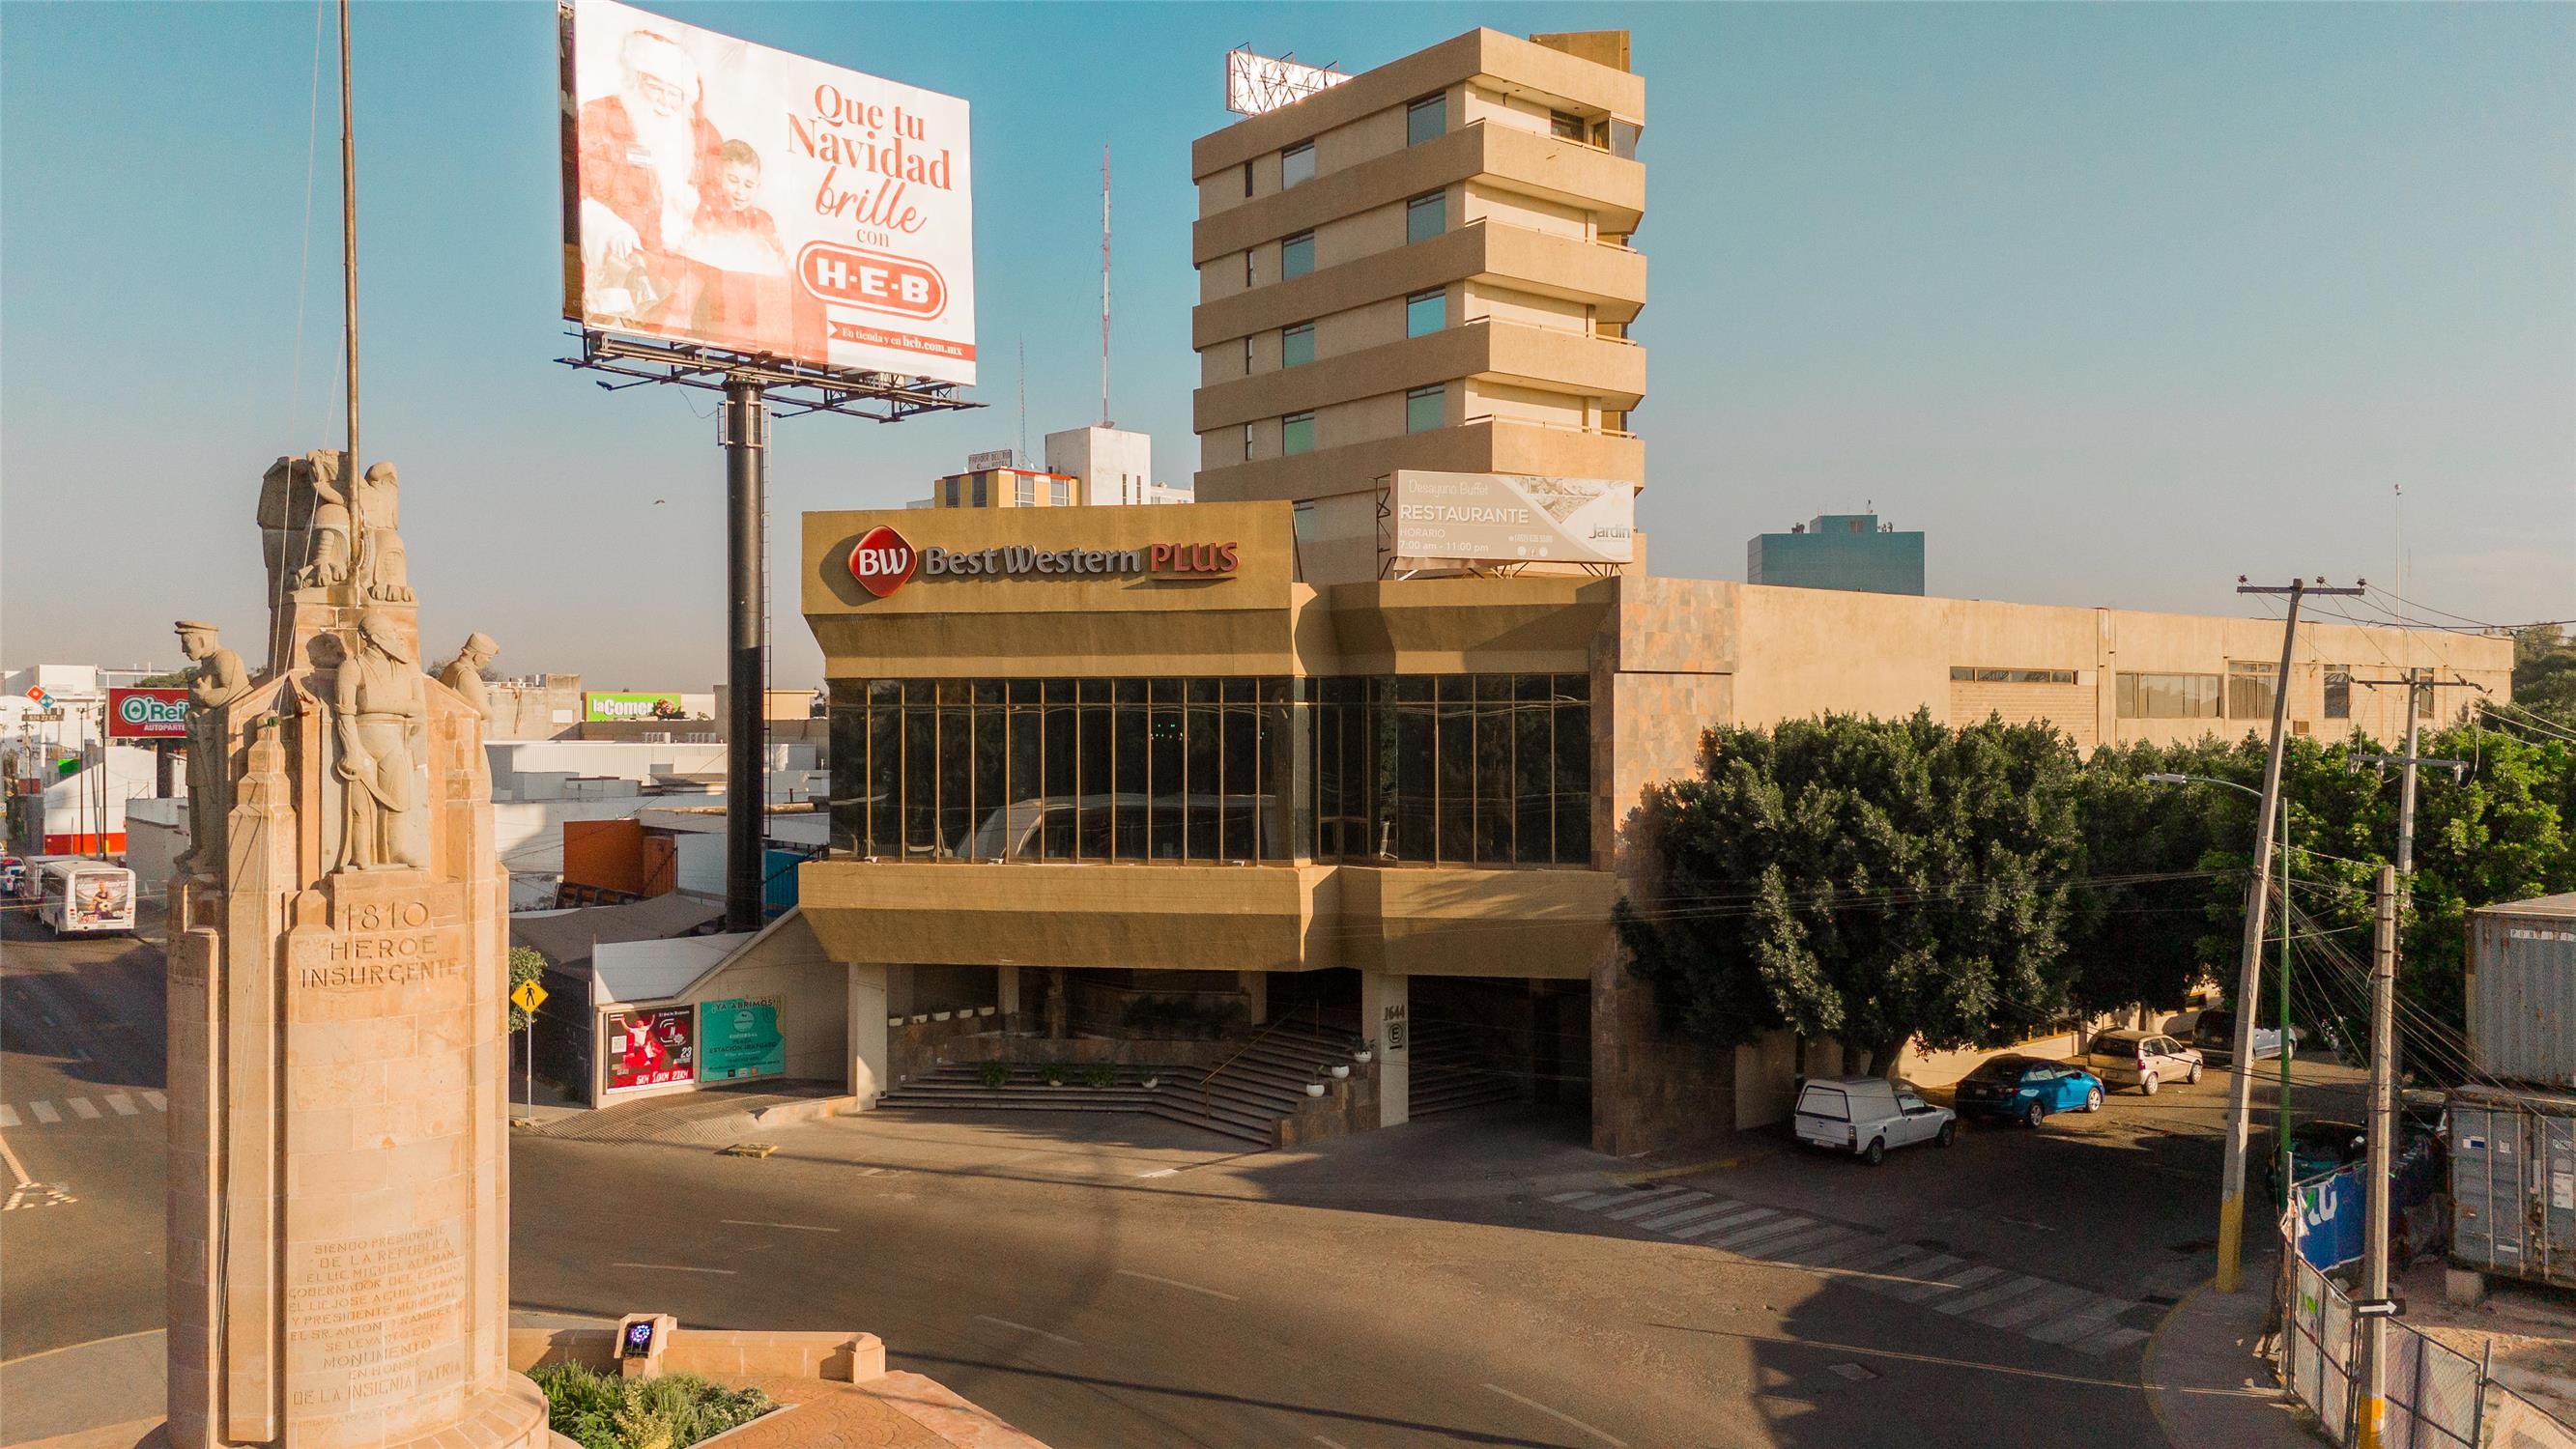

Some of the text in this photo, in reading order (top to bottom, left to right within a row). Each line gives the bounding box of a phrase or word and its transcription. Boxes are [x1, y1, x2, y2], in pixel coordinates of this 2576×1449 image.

[815, 84, 925, 141] Que tu
[787, 112, 952, 191] Navidad
[815, 165, 927, 234] brille
[856, 228, 889, 248] con
[842, 327, 963, 356] En tienda y en heb.com.mx
[1408, 479, 1488, 497] Desayuno Buffet
[1400, 504, 1529, 524] RESTAURANTE
[1399, 527, 1445, 539] HORARIO
[1399, 541, 1420, 550] 7:00
[1446, 542, 1472, 552] 11:00
[1474, 544, 1488, 553] pm
[858, 541, 1240, 577] BW Best Western PLUS
[343, 901, 429, 931] 1810
[330, 934, 438, 961] HEROE
[301, 957, 459, 988] INSURGENTE
[1383, 1005, 1406, 1021] 1644
[680, 1046, 692, 1059] 23
[314, 1227, 447, 1255] SIENDO PRESIDENTE
[320, 1257, 341, 1268] DE
[351, 1254, 372, 1265] LA
[306, 1273, 322, 1283] EL
[353, 1261, 403, 1276] MIGUEL
[288, 1279, 382, 1300] GOBERNADOR
[388, 1274, 414, 1287] DEL
[289, 1302, 304, 1313] EL
[333, 1294, 367, 1309] JOSE
[292, 1316, 300, 1325] Y
[303, 1308, 392, 1325] PRESIDENTE
[290, 1331, 307, 1342] EL
[324, 1338, 433, 1369] MONUMENTO
[325, 1343, 341, 1353] SE
[348, 1359, 421, 1380] EN HONOR
[293, 1389, 314, 1406] DE
[320, 1388, 341, 1404] LA
[348, 1375, 413, 1400] INSIGNIA
[417, 1360, 463, 1385] PATRIA
